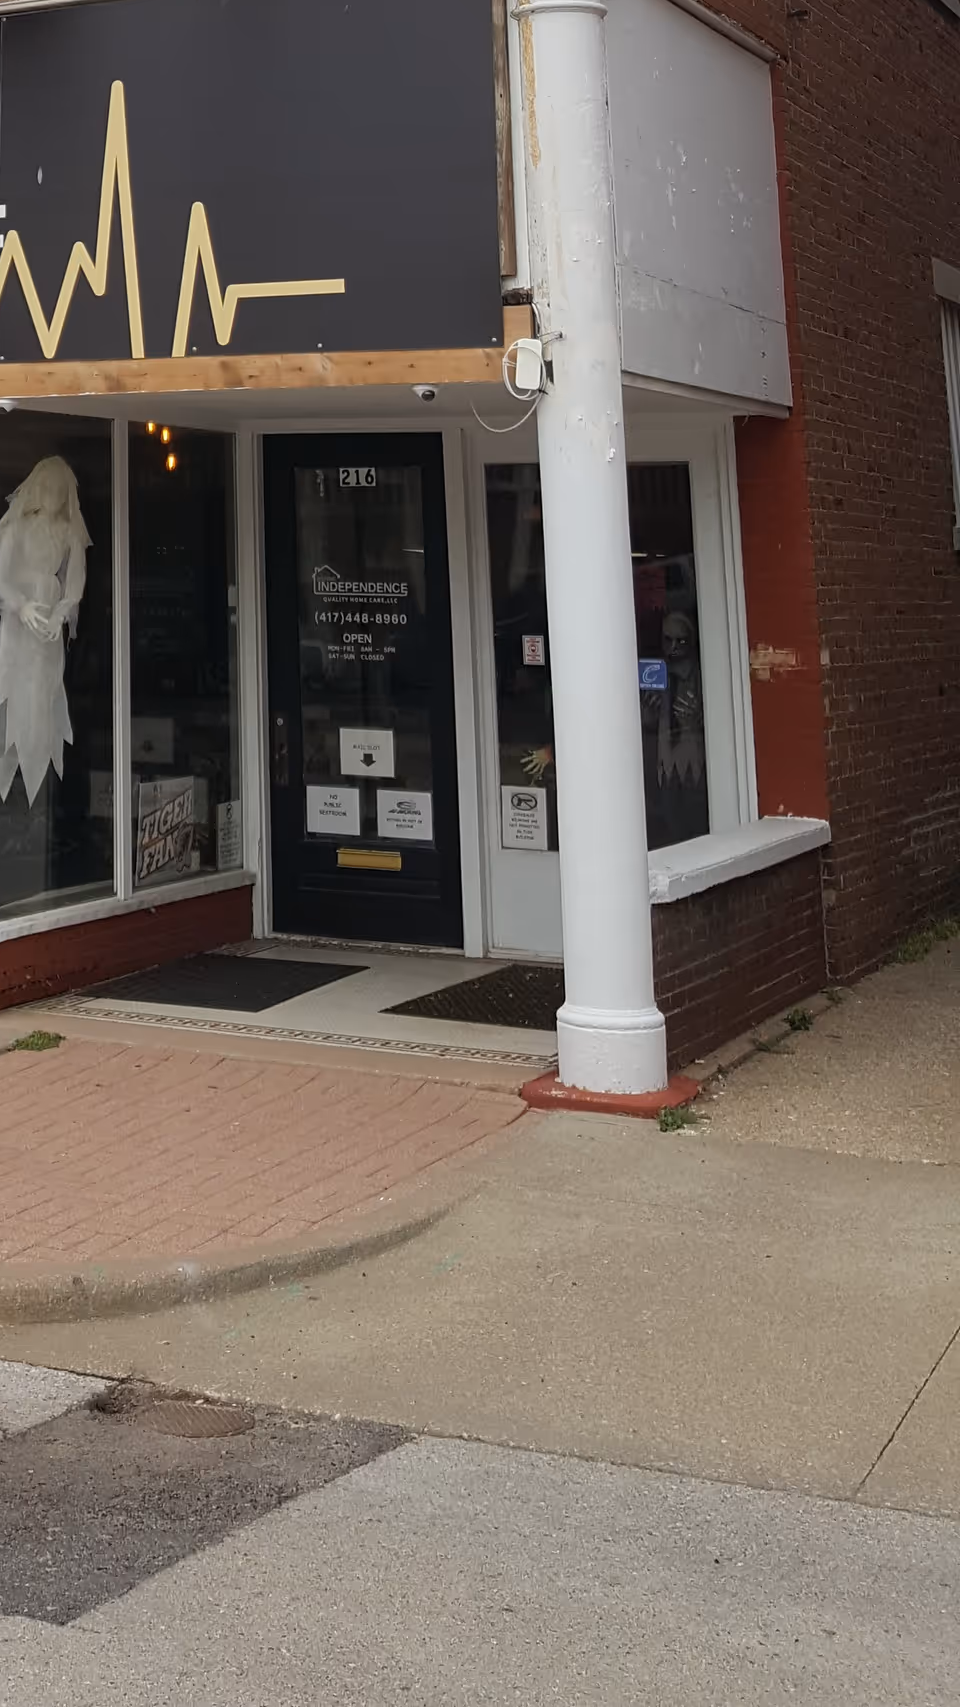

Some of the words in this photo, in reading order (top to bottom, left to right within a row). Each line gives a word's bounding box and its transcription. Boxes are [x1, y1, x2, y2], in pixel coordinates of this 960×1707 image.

[341, 468, 375, 485] 216
[317, 581, 408, 593] INDEPENDENCE
[343, 633, 372, 644] OPEN
[360, 653, 385, 661] CLOSED
